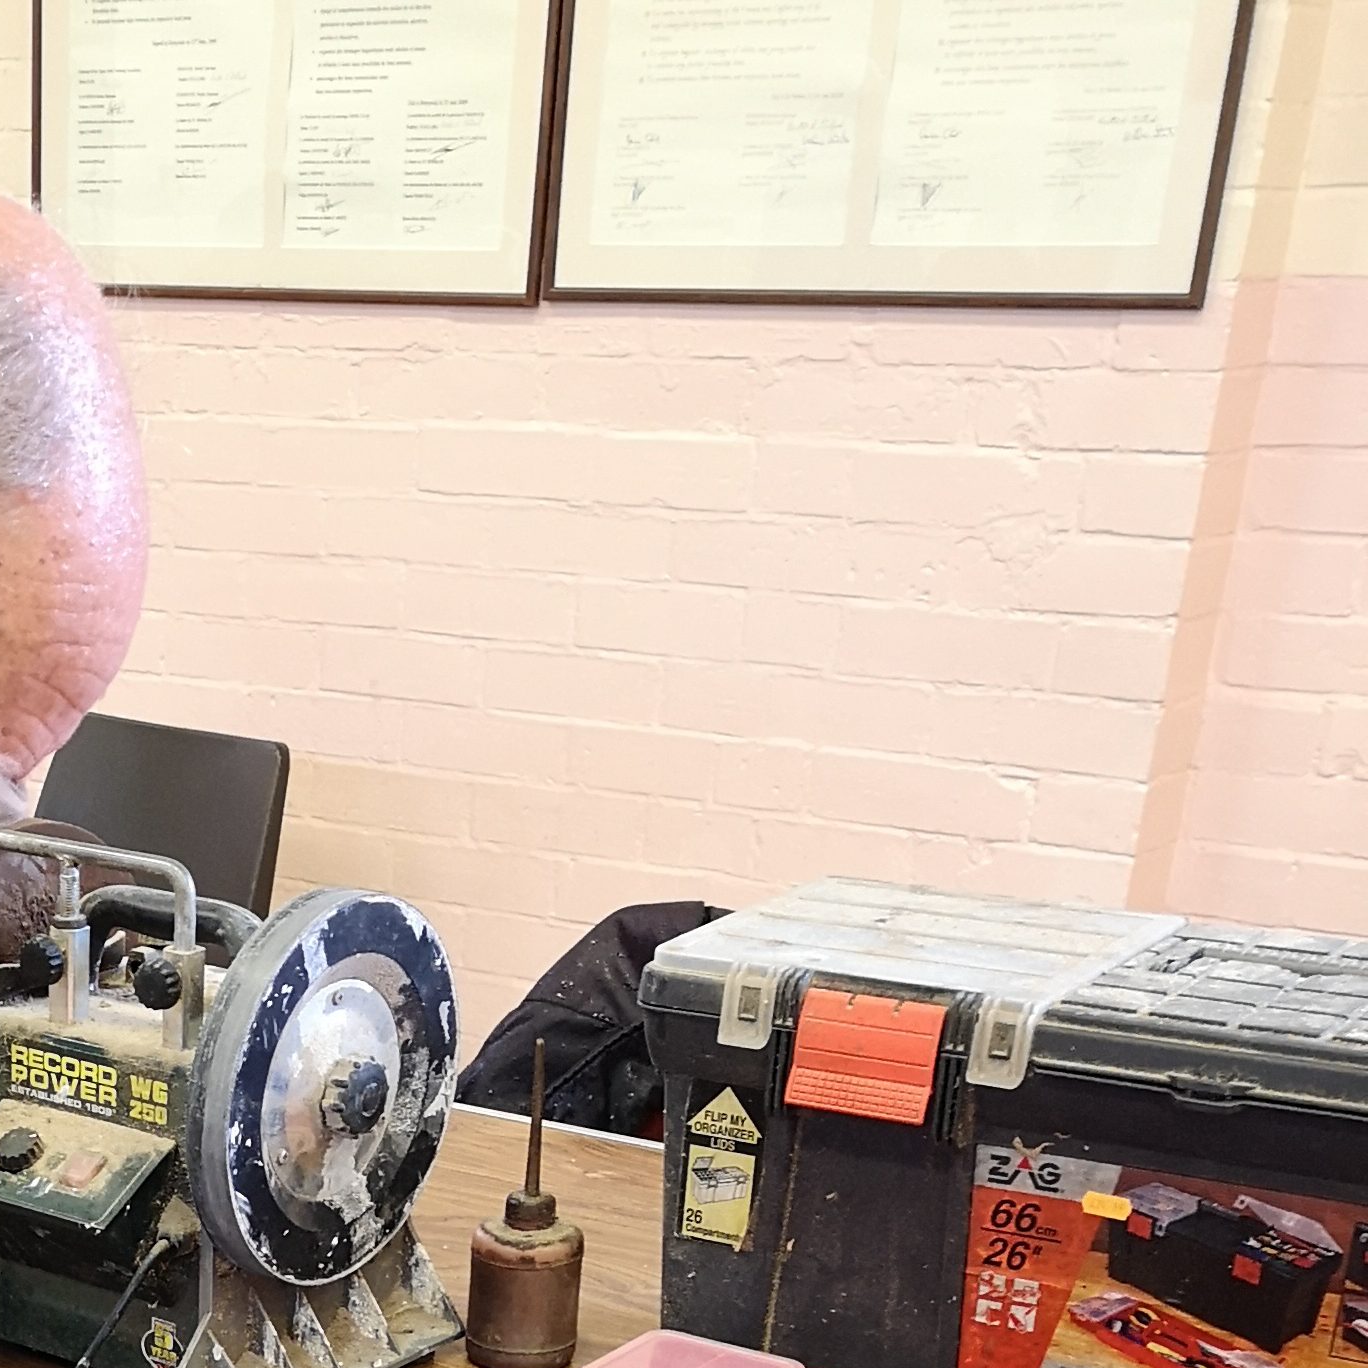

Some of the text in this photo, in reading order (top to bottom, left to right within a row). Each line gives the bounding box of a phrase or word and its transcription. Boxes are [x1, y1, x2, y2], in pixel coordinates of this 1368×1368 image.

[11, 1043, 117, 1087] RECORD
[11, 1063, 117, 1107] POWER
[130, 1075, 168, 1105] WG
[129, 1100, 168, 1125] 250
[704, 1110, 747, 1127] FLIP MY
[694, 1121, 755, 1141] ORGANIZER
[710, 1137, 736, 1151] LIDS
[988, 1153, 1062, 1194] ZAG
[686, 1207, 703, 1224] 26
